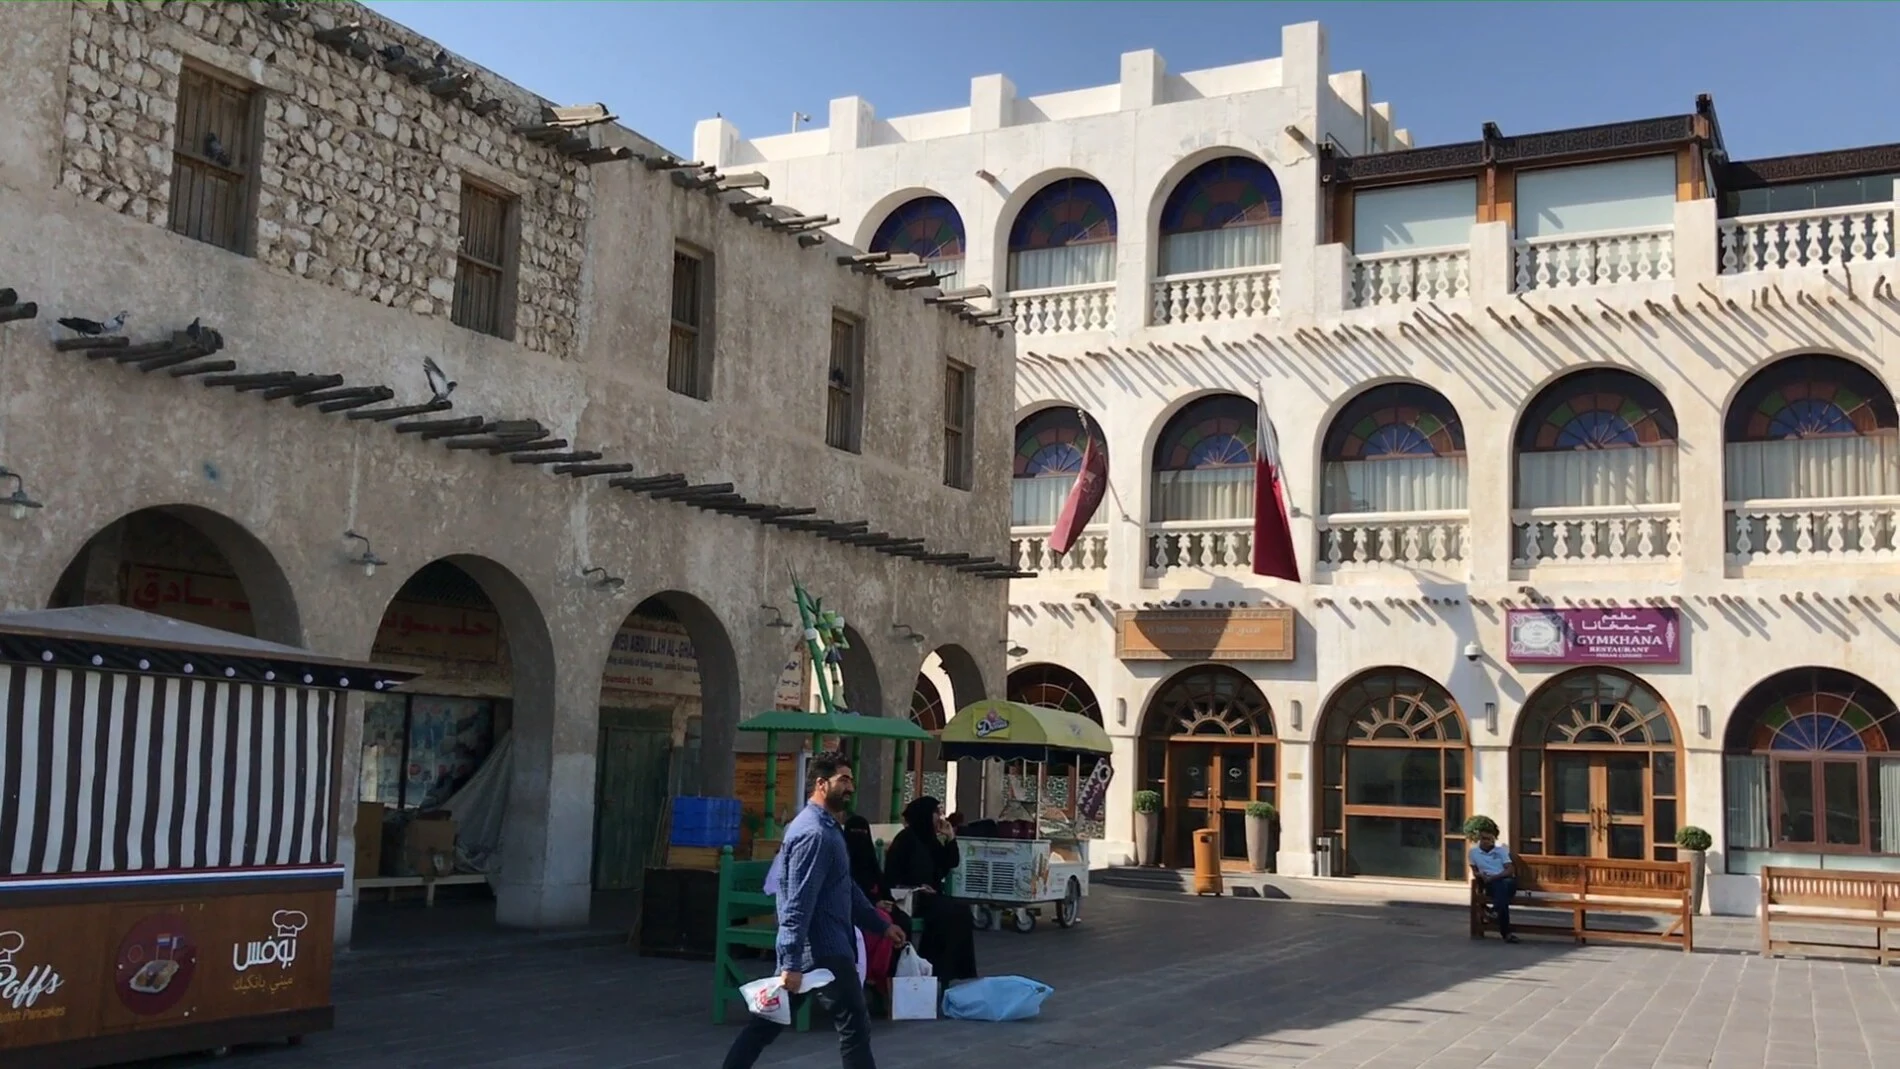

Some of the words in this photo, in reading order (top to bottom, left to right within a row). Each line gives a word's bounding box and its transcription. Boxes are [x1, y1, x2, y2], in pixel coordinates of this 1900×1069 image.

[1602, 611, 1636, 623] مطعم
[1582, 620, 1656, 633] جيمخانا
[1577, 635, 1663, 645] GYMKHANA
[232, 935, 297, 971] بوفس
